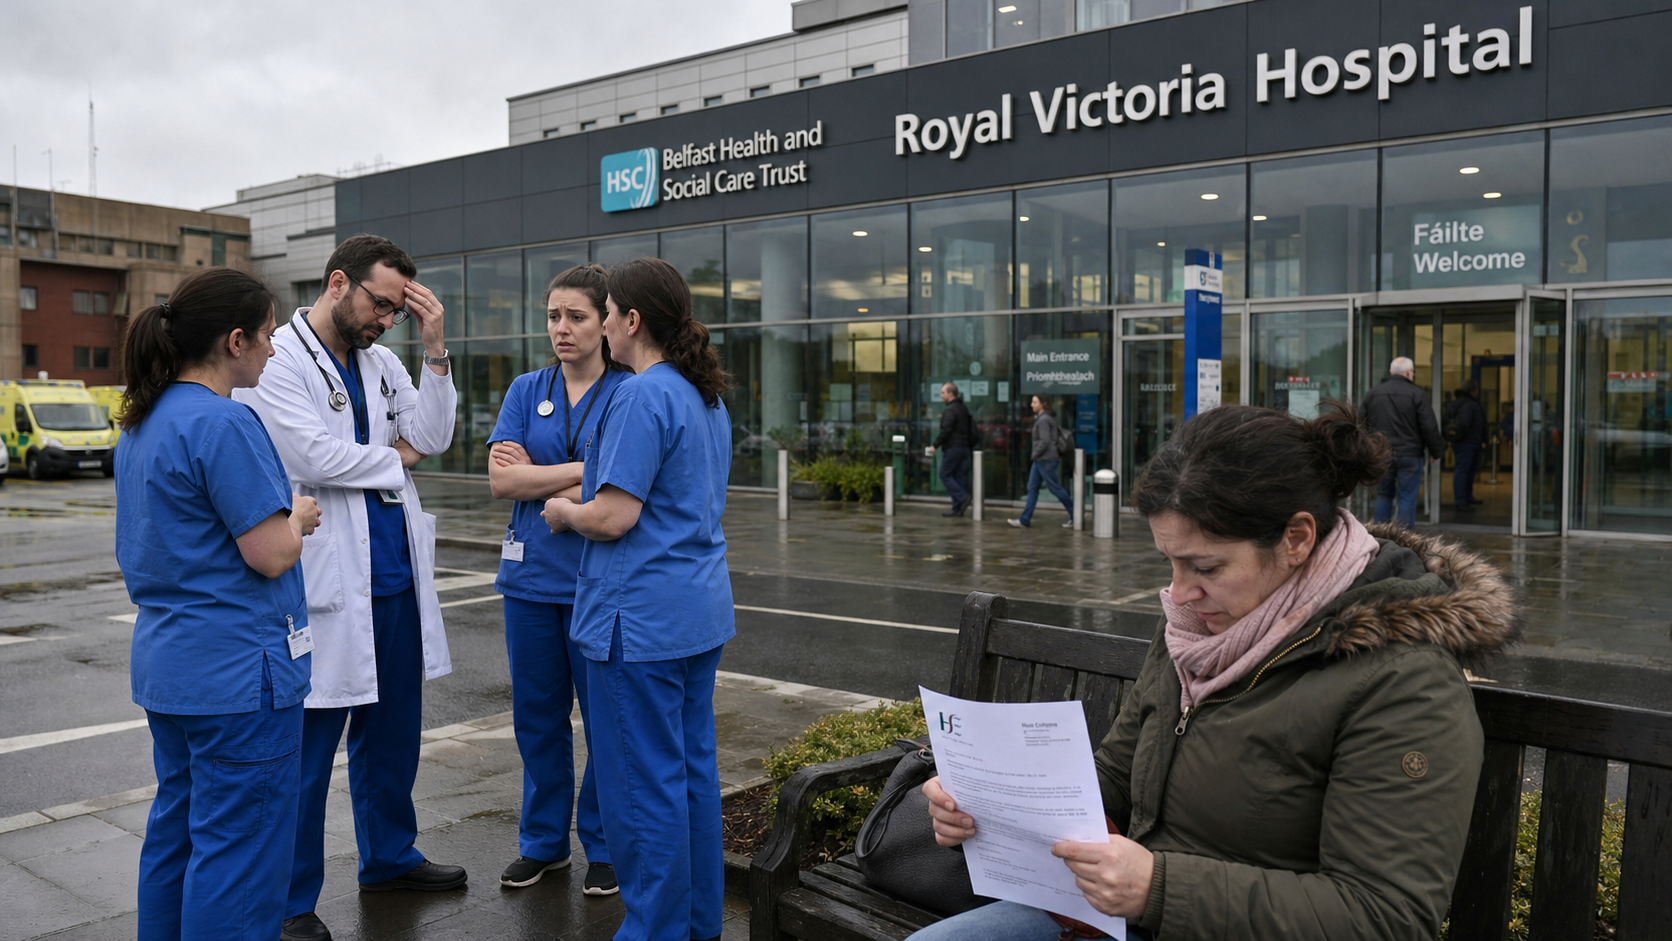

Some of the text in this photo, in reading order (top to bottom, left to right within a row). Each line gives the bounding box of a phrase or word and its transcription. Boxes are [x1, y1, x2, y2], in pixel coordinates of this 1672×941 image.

[893, 5, 1534, 160] Royal Victoria Hospital
[662, 120, 823, 171] Belfast Health and
[607, 166, 644, 194] HSC
[662, 160, 808, 201] Social Care Trust
[1413, 220, 1485, 246] Fáilte
[1413, 250, 1526, 274] Welcome
[1026, 351, 1090, 363] Main Entrance
